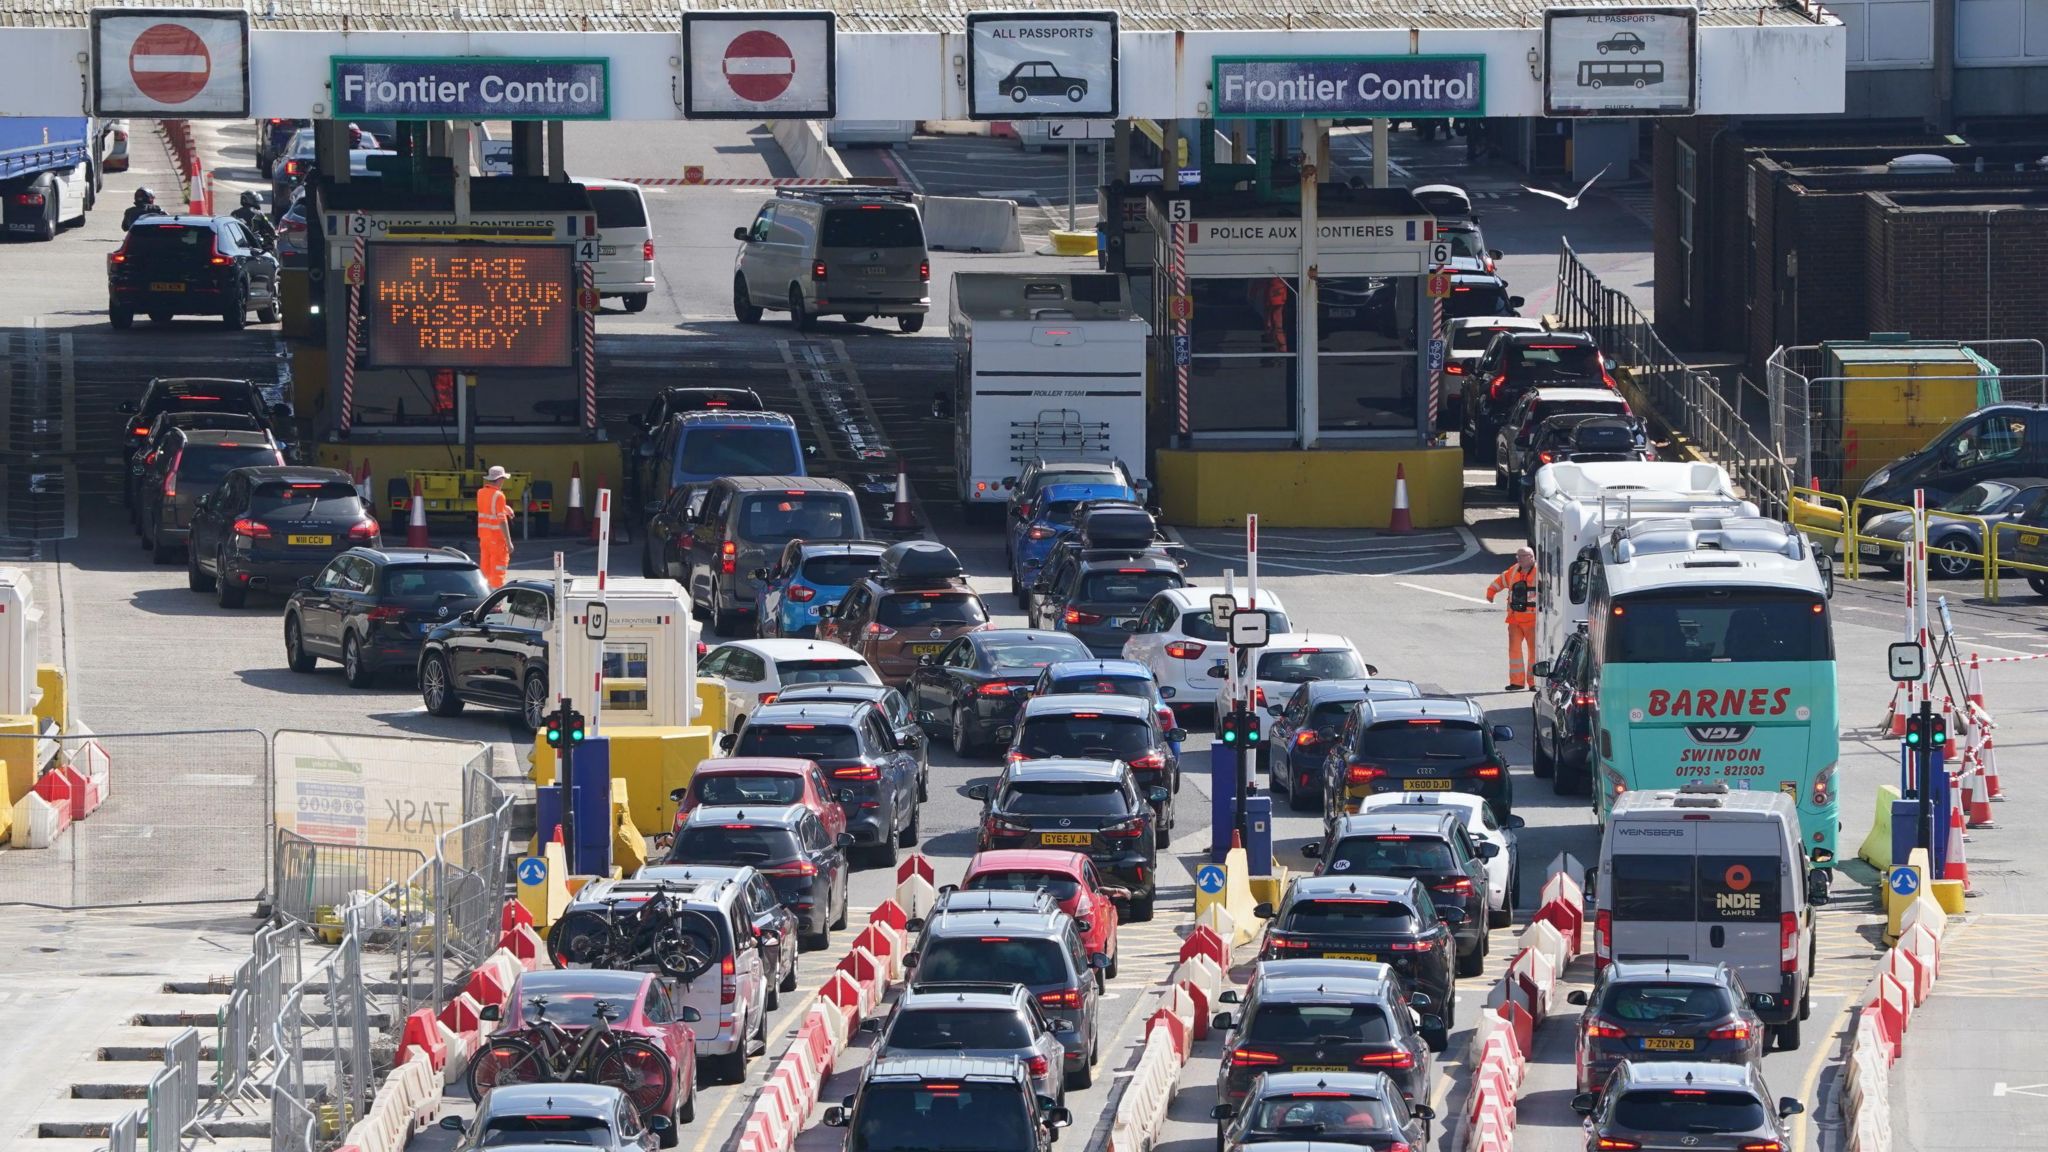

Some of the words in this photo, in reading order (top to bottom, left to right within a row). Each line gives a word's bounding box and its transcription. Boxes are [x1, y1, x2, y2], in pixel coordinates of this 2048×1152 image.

[1587, 15, 1603, 23] ALL
[1604, 15, 1656, 23] PASSPORTS
[992, 28, 1016, 39] ALL
[1019, 27, 1094, 39] PASSPORTS
[344, 75, 470, 102] Frontier
[479, 75, 597, 103] Control
[1225, 73, 1348, 101] Frontier
[1357, 72, 1473, 101] Control
[1173, 202, 1186, 220] 5
[354, 217, 366, 233] 3
[1210, 226, 1264, 239] POLICE
[1268, 226, 1297, 239] AUX
[1316, 225, 1394, 238] ONTIERES
[580, 243, 593, 259] 4
[1434, 246, 1447, 262] 6
[411, 257, 526, 279] PLEASE
[379, 281, 460, 301] HAVE
[482, 282, 562, 303] YOUR
[391, 304, 550, 326] PASSPORT
[420, 328, 519, 348] READY
[1218, 605, 1230, 620] H
[592, 613, 602, 629] G
[1648, 687, 1791, 719] BARNES
[1631, 711, 1642, 720] 80
[1797, 709, 1809, 717] 100
[1696, 727, 1741, 740] VDL
[1680, 748, 1761, 762] SWINDON
[1676, 766, 1711, 777] 01793
[1723, 765, 1765, 776] 821303
[1409, 780, 1431, 789] X600
[1618, 828, 1685, 837] WEINSBERG
[1335, 861, 1348, 869] UK
